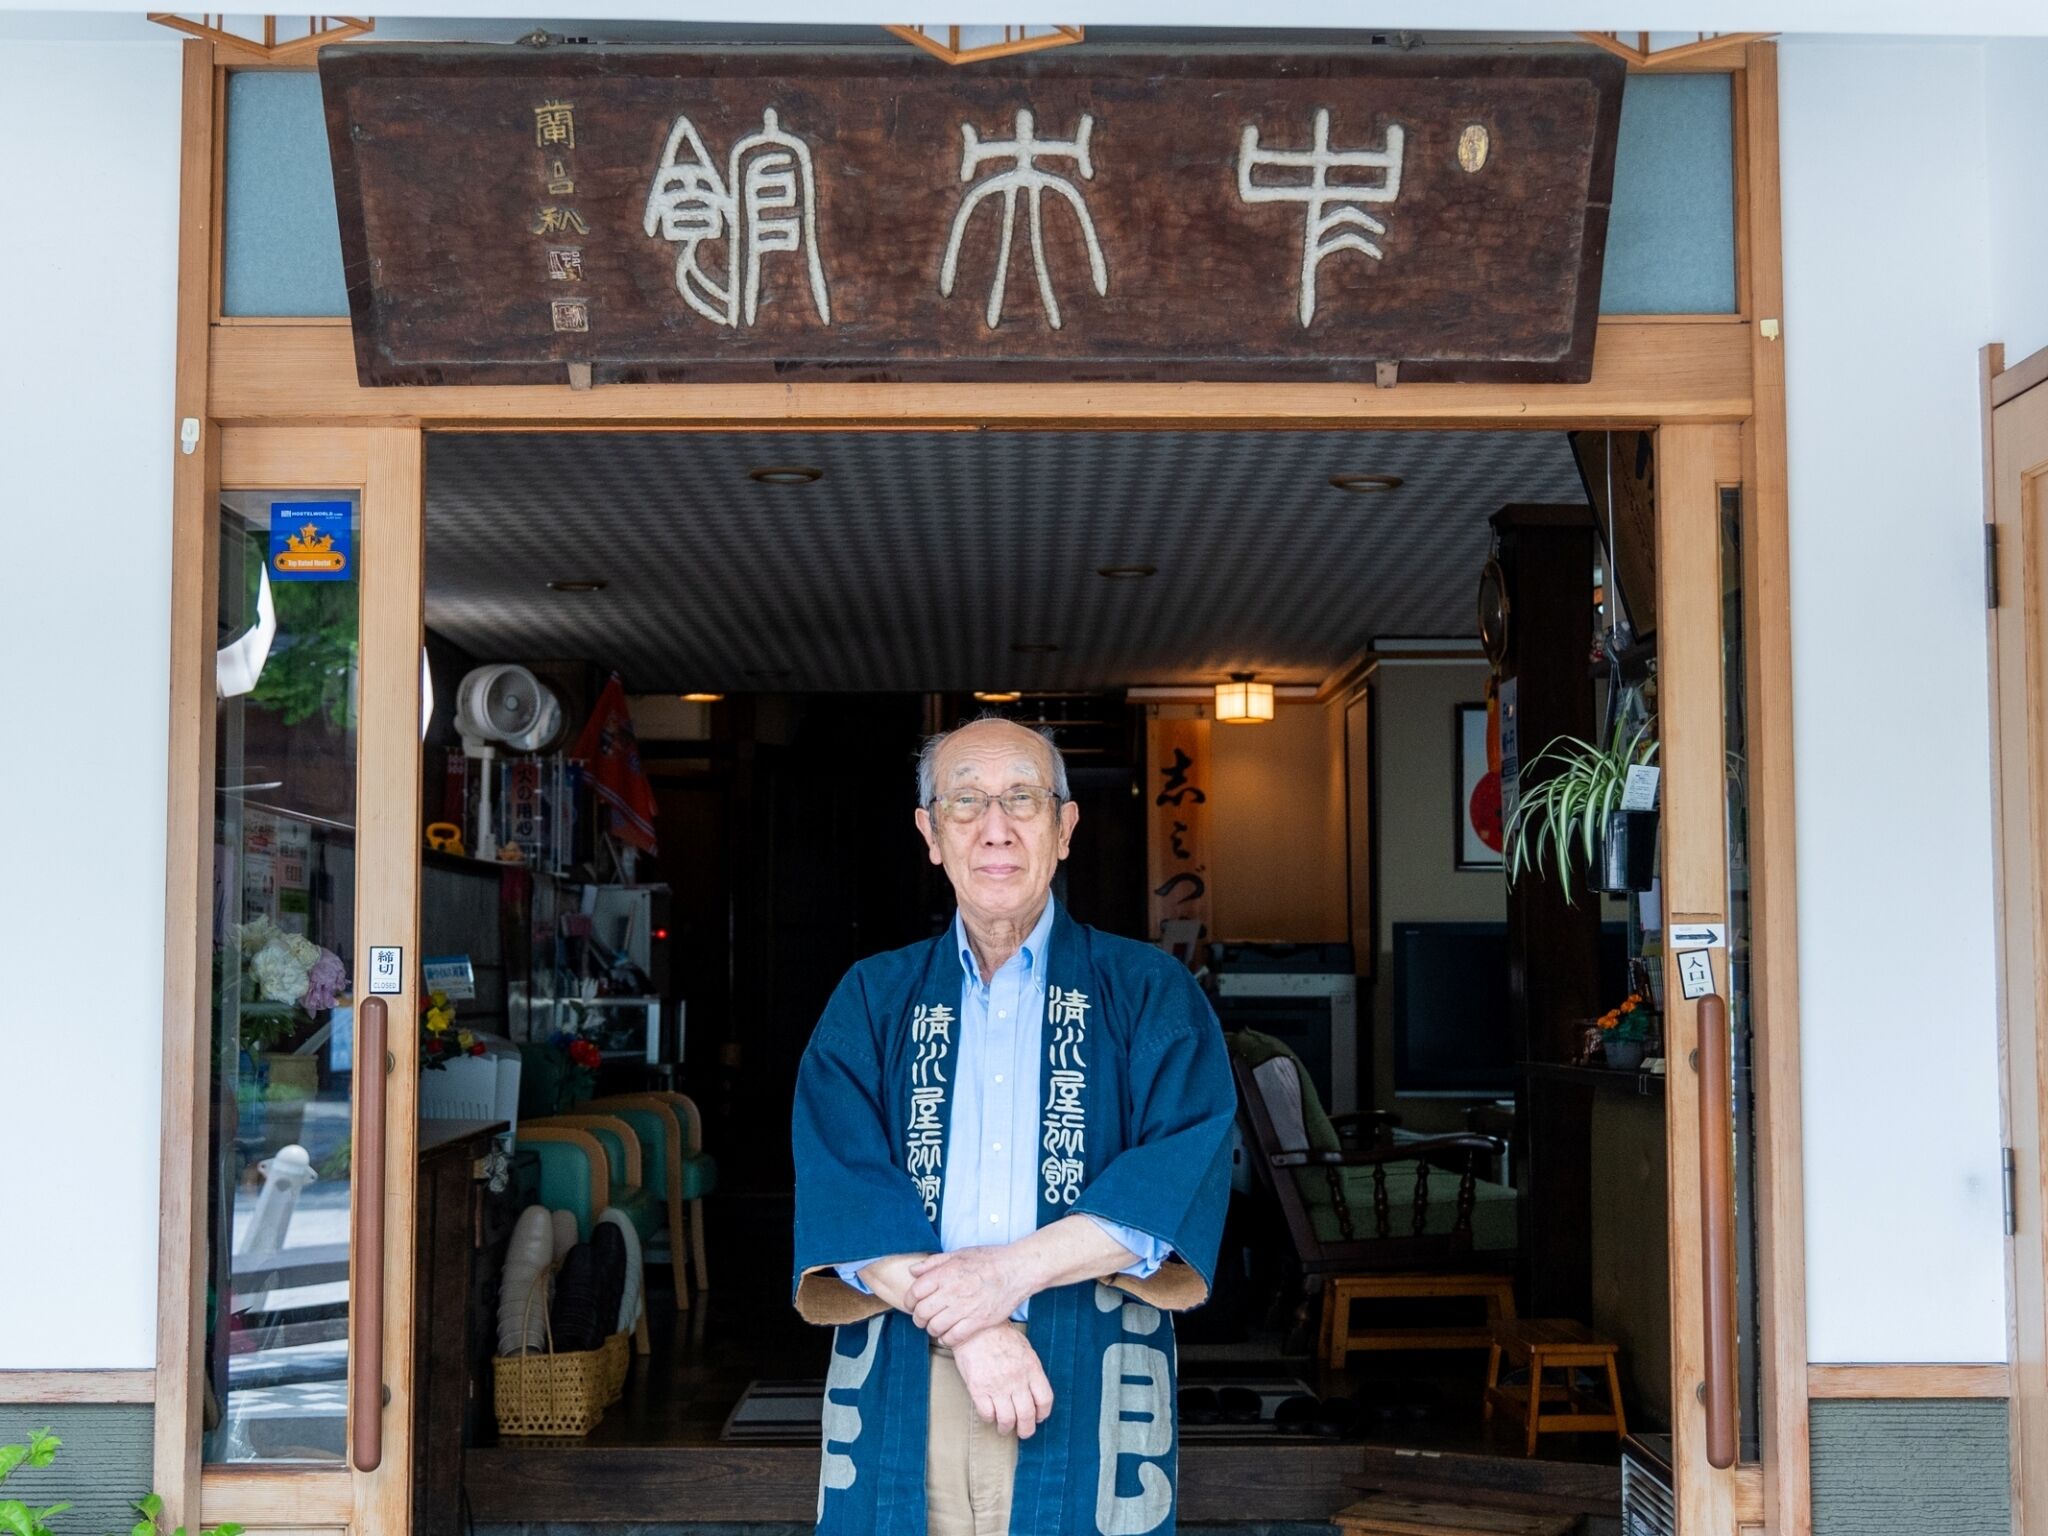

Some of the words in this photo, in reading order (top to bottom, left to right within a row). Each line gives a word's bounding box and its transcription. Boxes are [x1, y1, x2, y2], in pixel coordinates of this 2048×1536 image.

[378, 950, 395, 975] 締切
[1687, 956, 1704, 982] 入口
[373, 981, 397, 990] CLOSED
[1042, 985, 1091, 1205] 清水屋旅館
